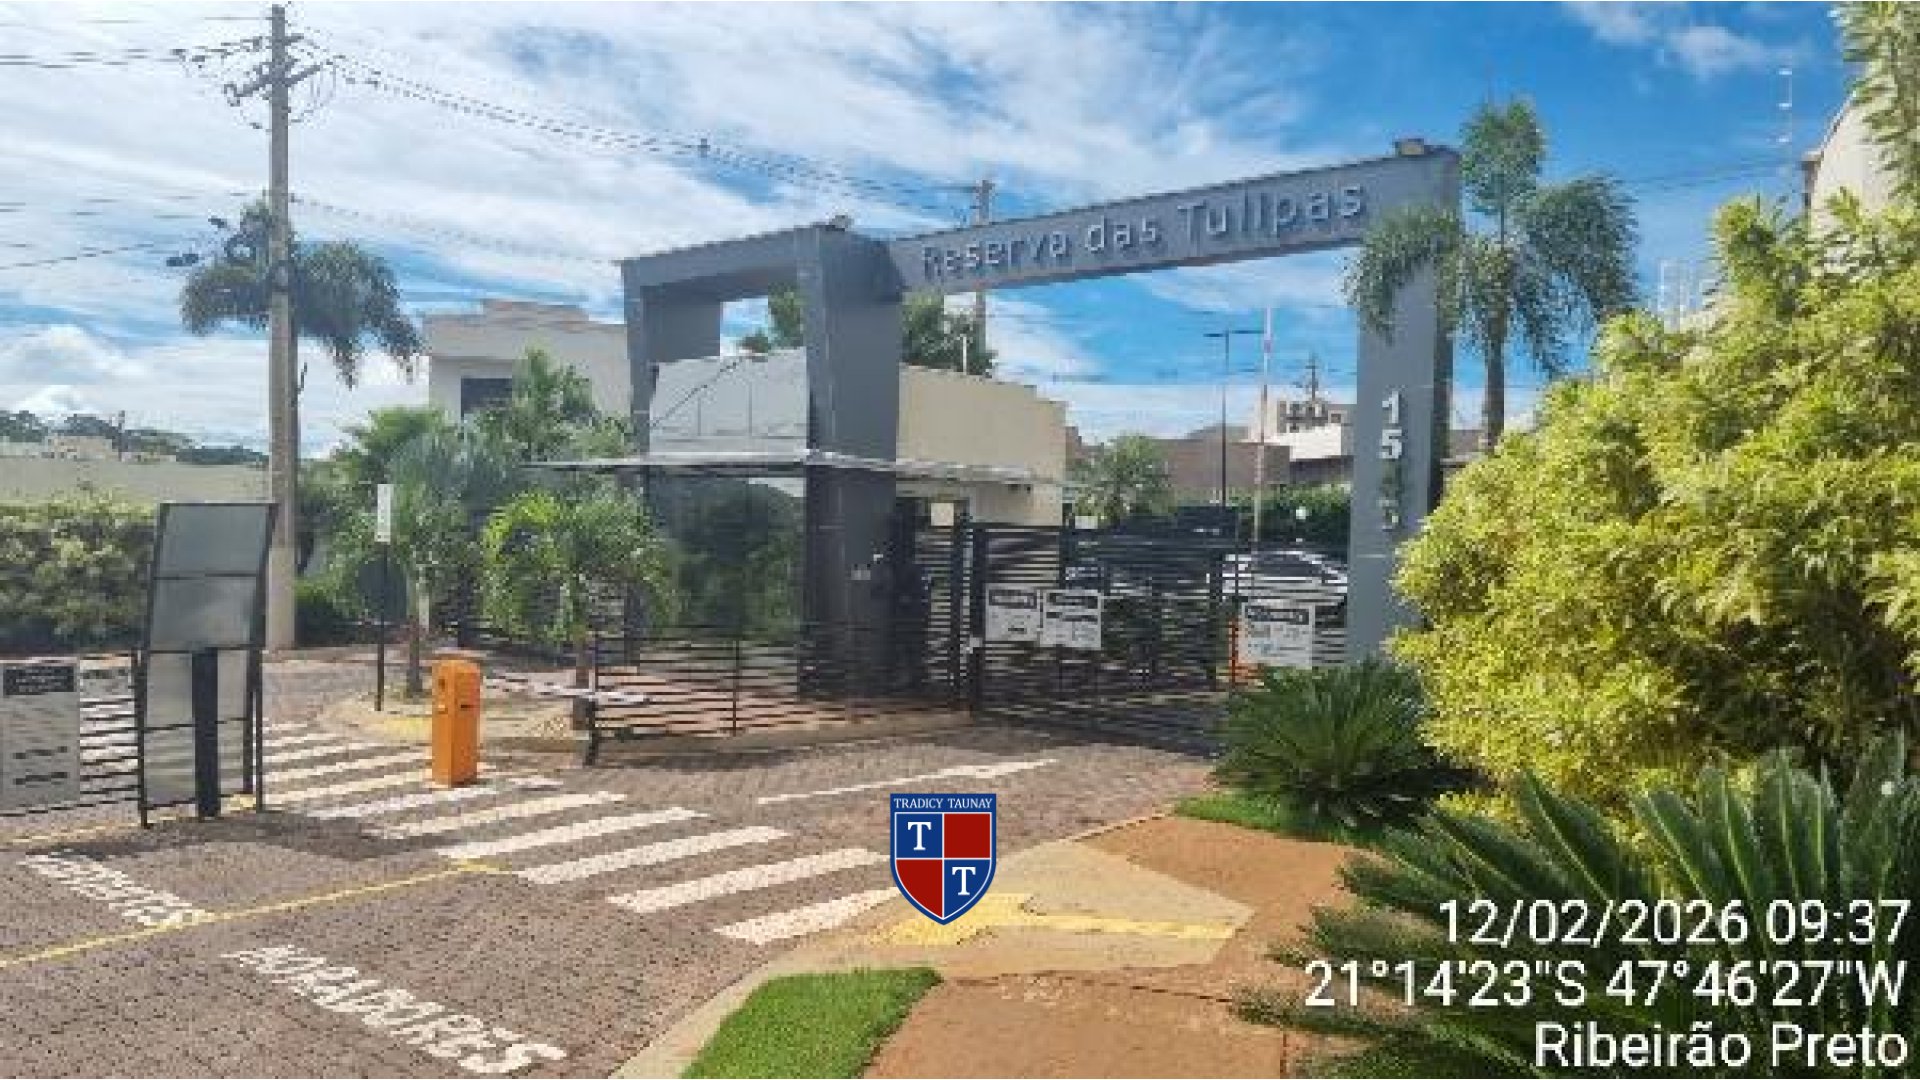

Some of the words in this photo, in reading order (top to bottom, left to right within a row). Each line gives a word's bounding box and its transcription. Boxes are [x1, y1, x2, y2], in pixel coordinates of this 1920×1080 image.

[921, 230, 1070, 281] Reserva
[1083, 213, 1161, 255] das
[1176, 185, 1363, 245] Tulipas
